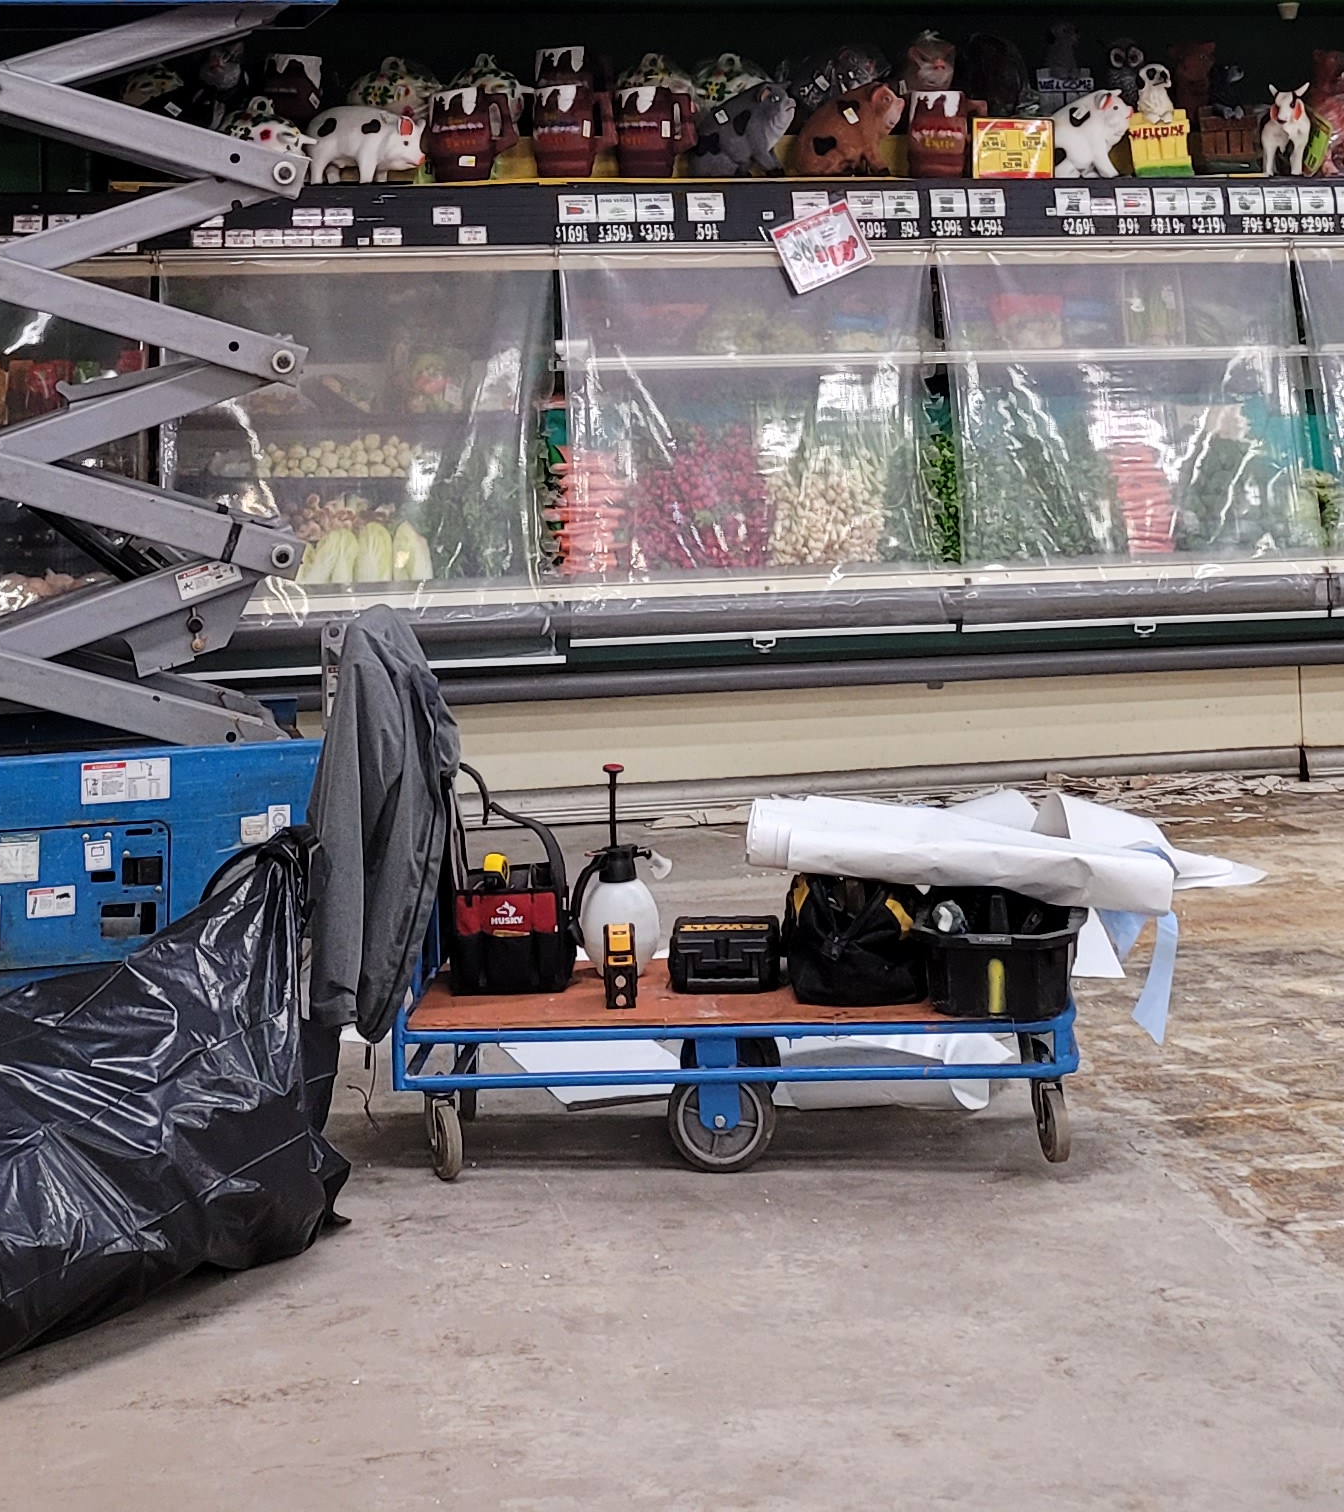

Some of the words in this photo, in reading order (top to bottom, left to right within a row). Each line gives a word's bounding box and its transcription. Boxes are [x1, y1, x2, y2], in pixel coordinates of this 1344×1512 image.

[1038, 77, 1093, 92] WELCOME
[1130, 123, 1186, 139] WELCOME
[490, 915, 524, 926] HUSKY
